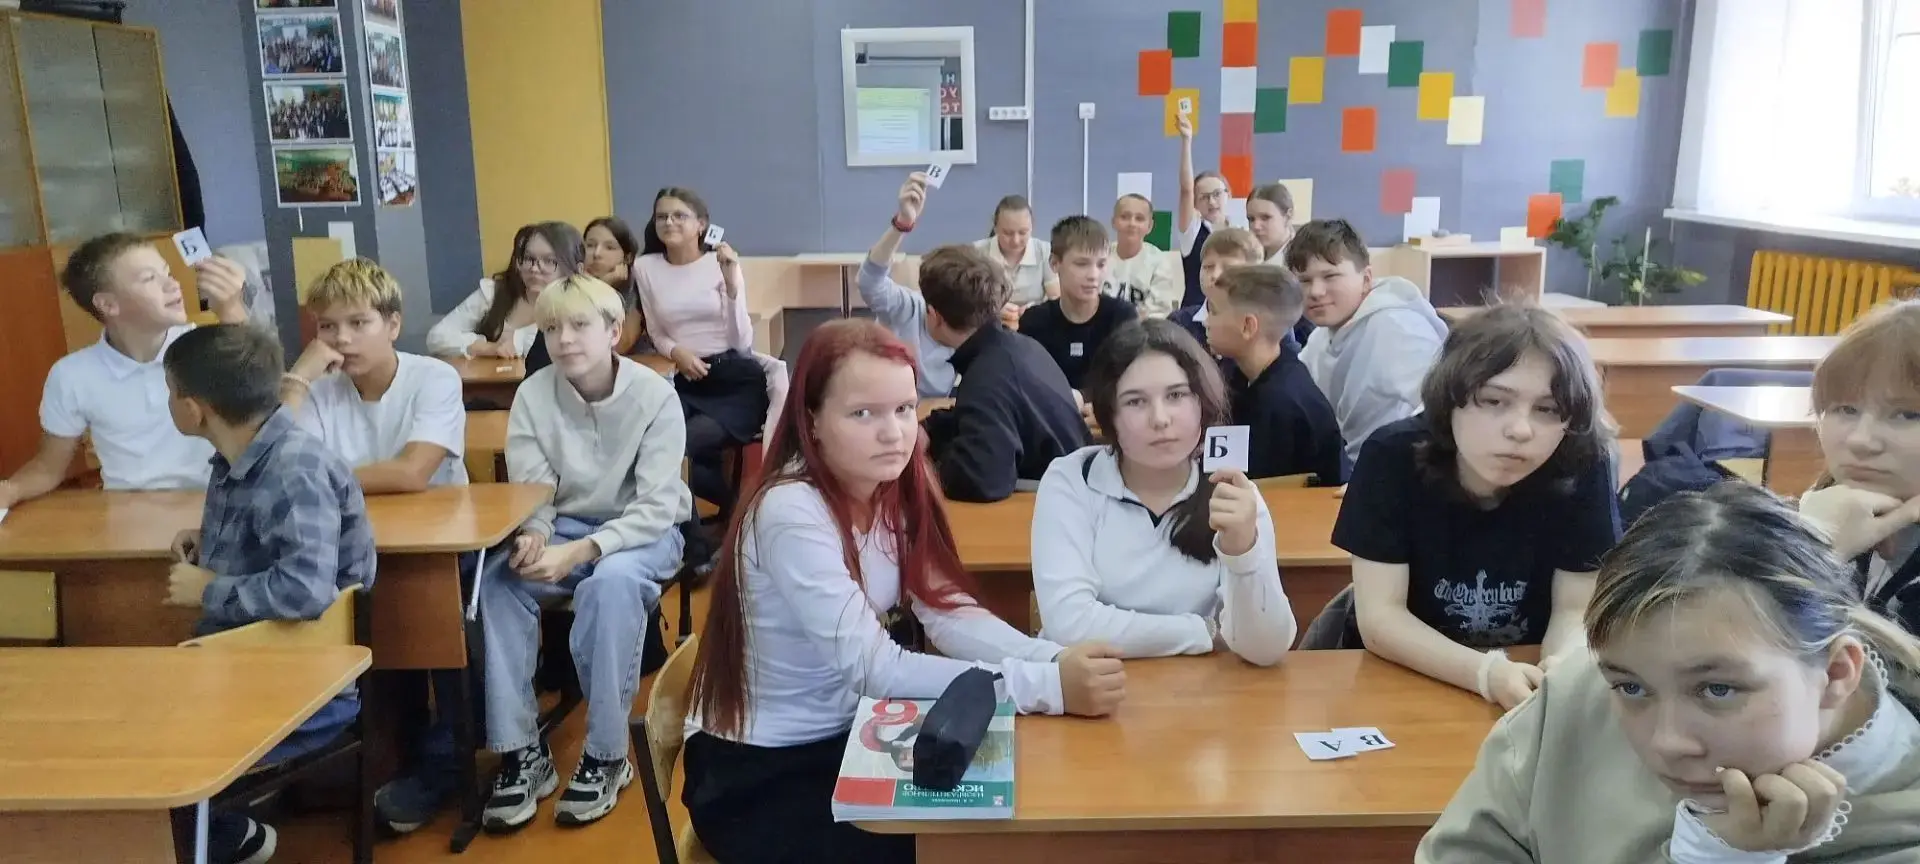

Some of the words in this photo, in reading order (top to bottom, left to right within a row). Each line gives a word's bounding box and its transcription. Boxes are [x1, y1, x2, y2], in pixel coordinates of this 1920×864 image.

[929, 165, 942, 178] В
[181, 238, 198, 257] Б
[1208, 434, 1228, 459] Б
[1360, 734, 1386, 746] В
